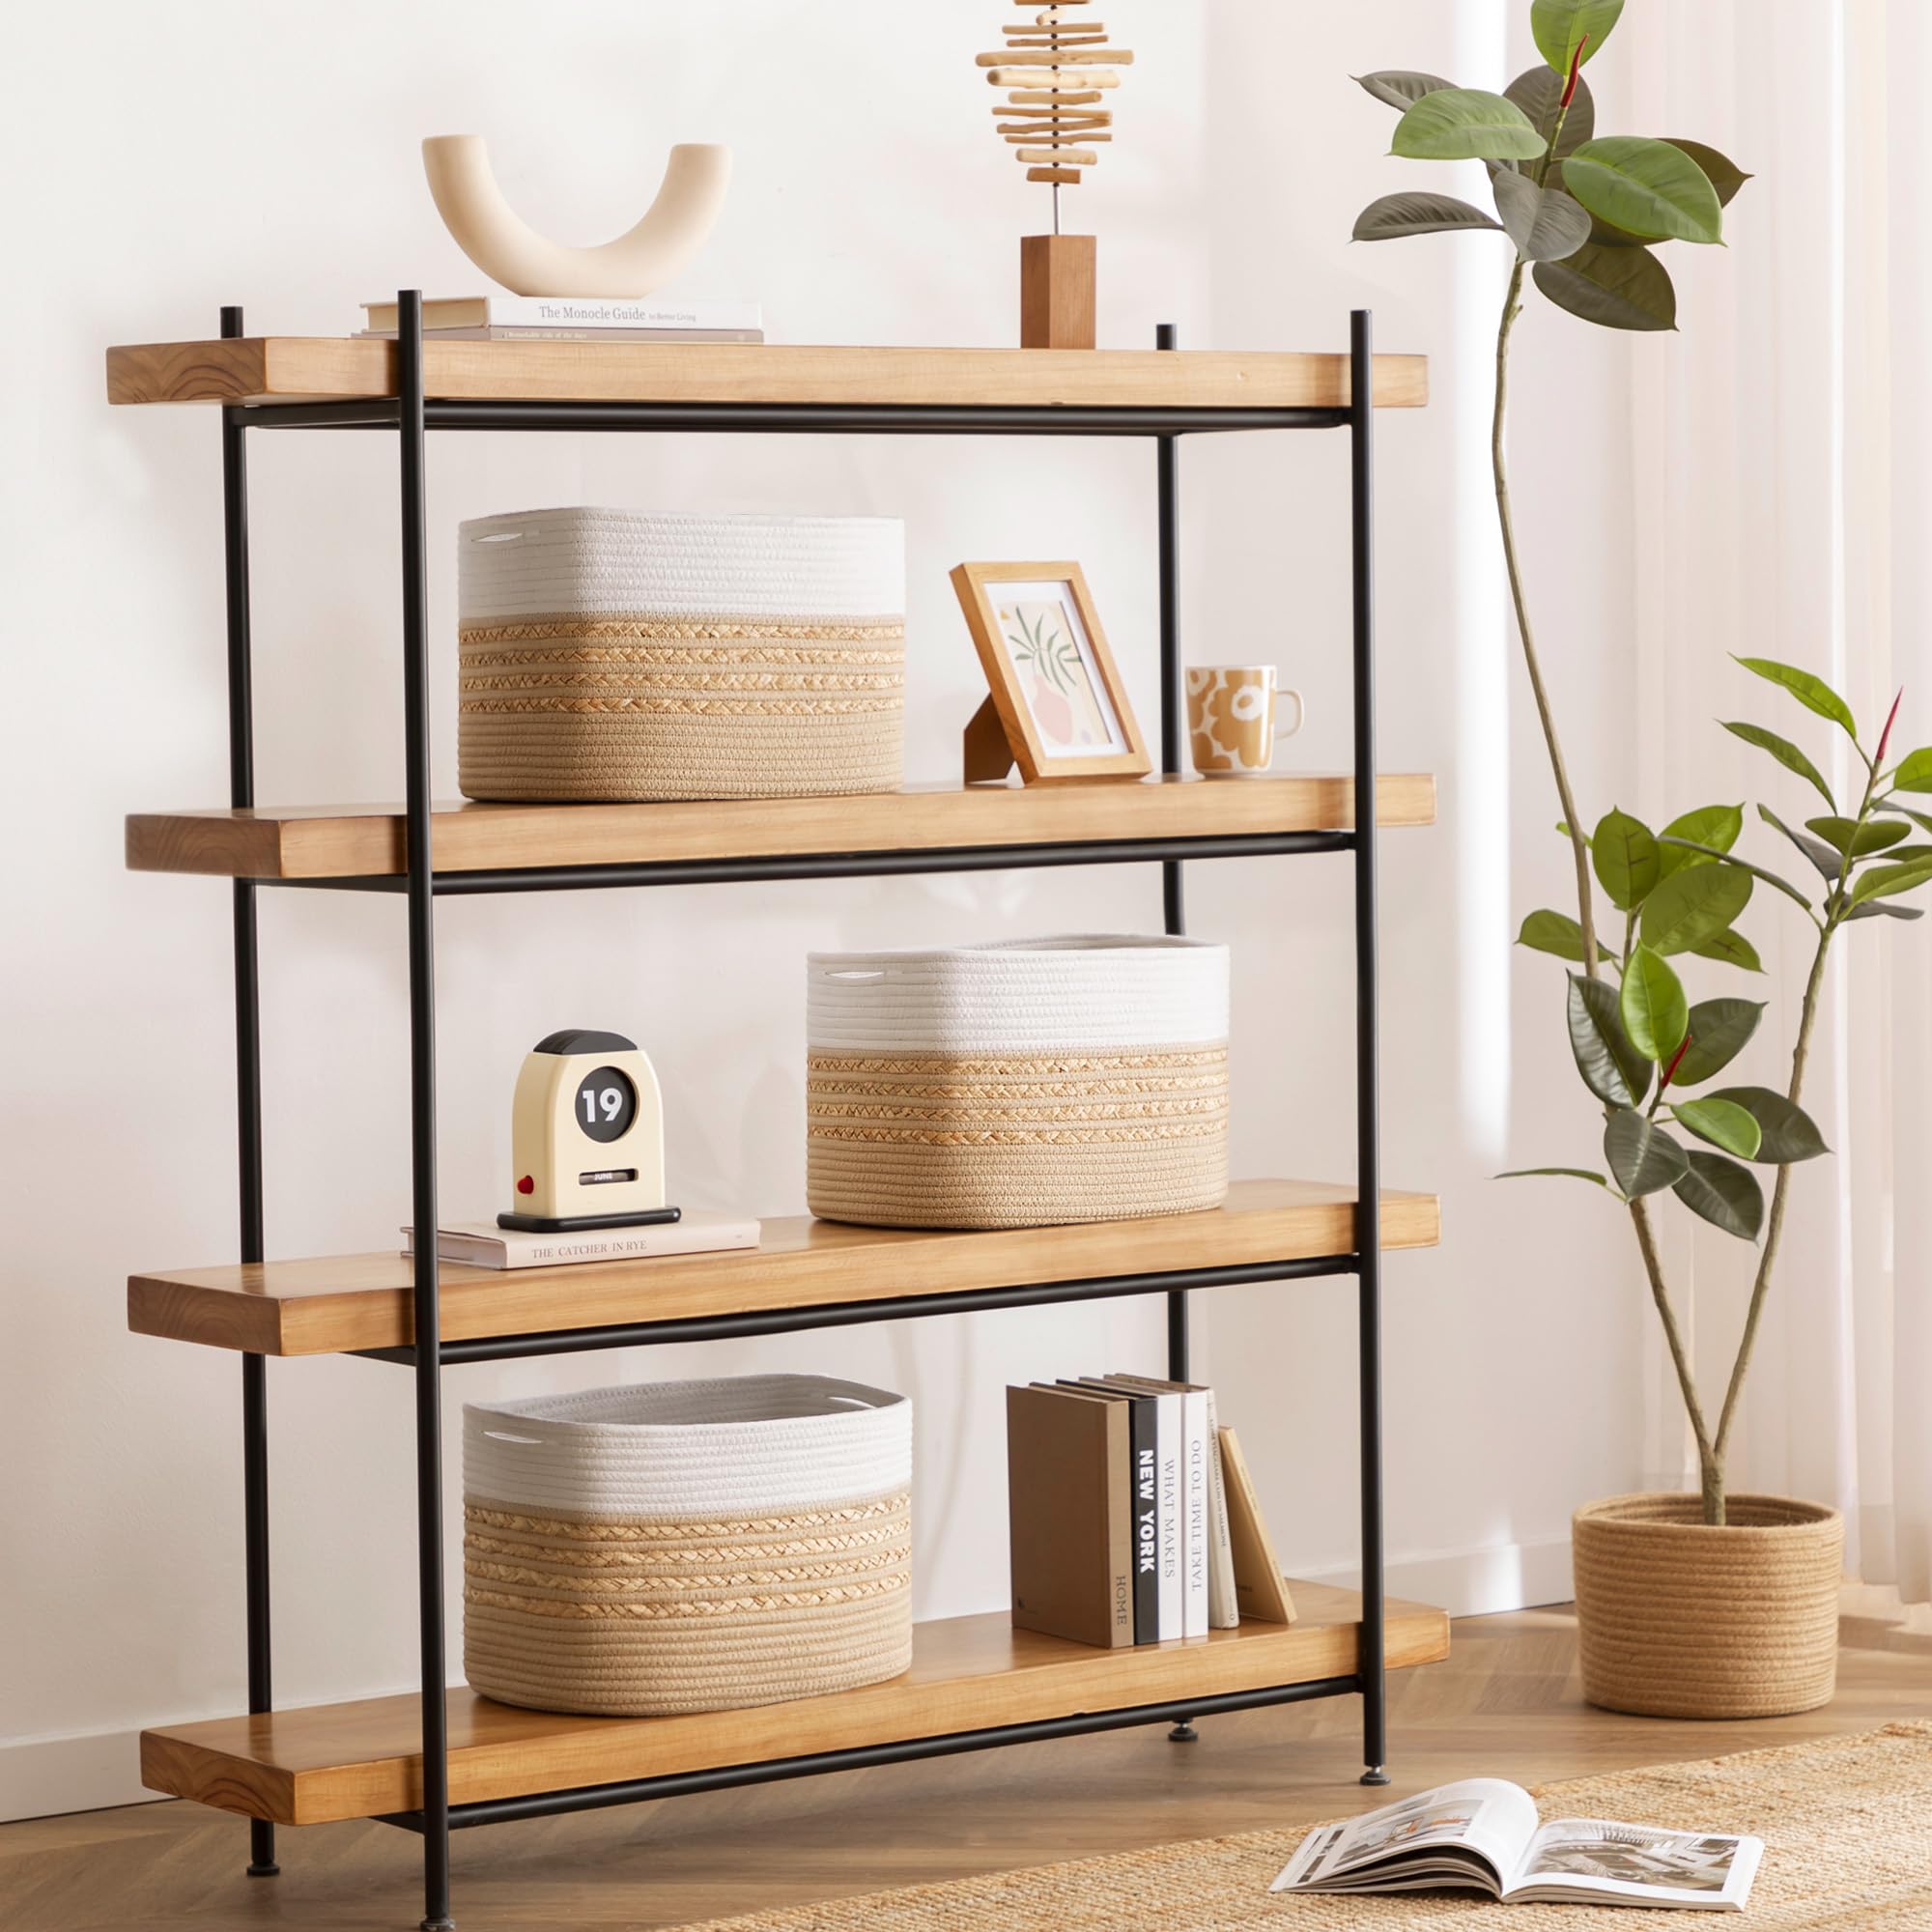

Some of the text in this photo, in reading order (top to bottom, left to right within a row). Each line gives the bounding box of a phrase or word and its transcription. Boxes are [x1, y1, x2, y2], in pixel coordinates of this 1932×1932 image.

[539, 306, 560, 319] The
[563, 306, 609, 320] Monocle
[612, 307, 645, 321] Guide
[582, 1088, 623, 1122] 19
[531, 1240, 647, 1259] THE CATCHER IN RYE
[1140, 1450, 1155, 1574] NEW YORK
[1164, 1459, 1176, 1577] WHAT MAKES
[1191, 1440, 1202, 1592] TAKE TIME TO DO
[1116, 1576, 1127, 1626] HOME
